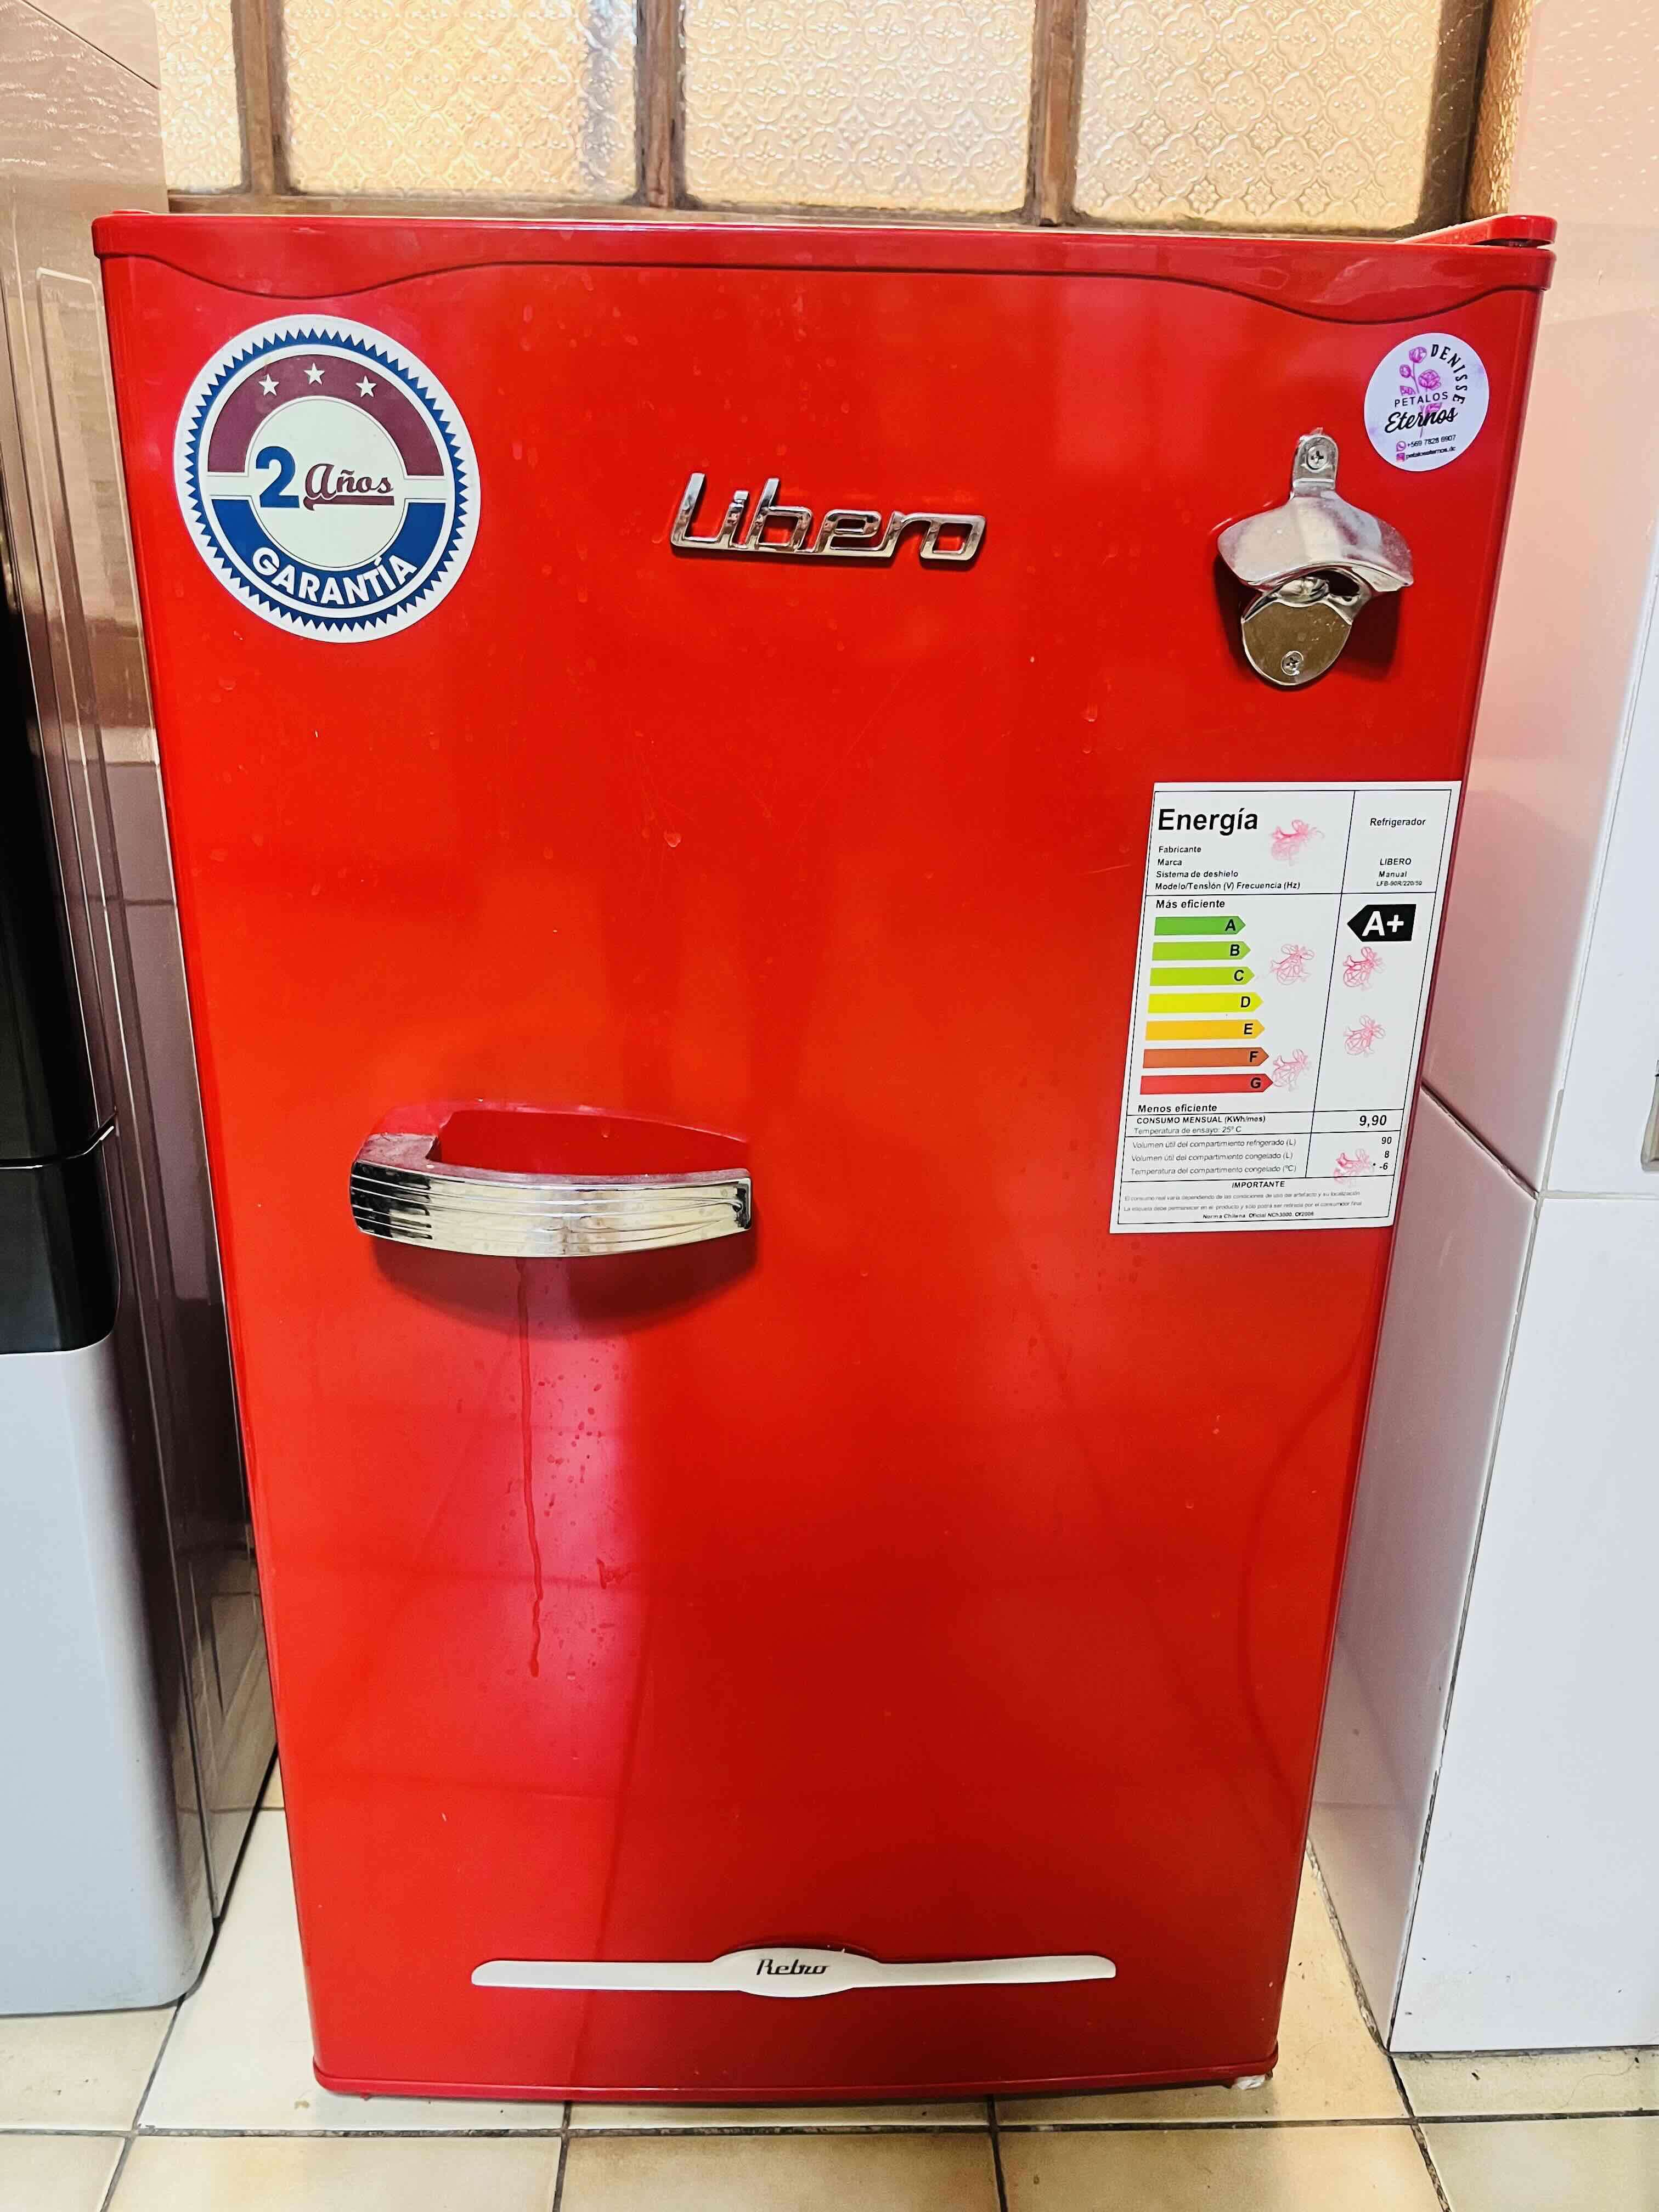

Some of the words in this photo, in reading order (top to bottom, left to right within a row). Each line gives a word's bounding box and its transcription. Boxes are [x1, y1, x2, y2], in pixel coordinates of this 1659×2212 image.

[1431, 344, 1468, 404] DENISSE
[1395, 392, 1448, 407] PETALOS
[1384, 407, 1458, 433] Eternos
[255, 445, 300, 508] 2
[303, 463, 394, 511] Años
[670, 473, 986, 561] Libero
[252, 546, 417, 605] GARANTÍA
[1158, 808, 1258, 836] Energía
[1370, 818, 1426, 827] Refrigerador
[1223, 882, 1234, 890] (V)
[1156, 900, 1177, 909] Más
[1181, 900, 1224, 908] eficiente
[1225, 919, 1237, 931] A
[1362, 911, 1404, 936] A+
[1229, 945, 1240, 956] B
[1234, 970, 1244, 981] C
[1240, 996, 1251, 1008] D
[1244, 1023, 1254, 1035] E
[1249, 1051, 1258, 1062] F
[1250, 1077, 1261, 1088] G
[1359, 1115, 1387, 1127] 9,90
[1189, 1153, 1243, 1161] compartimiento
[757, 1959, 830, 1975] Retro
